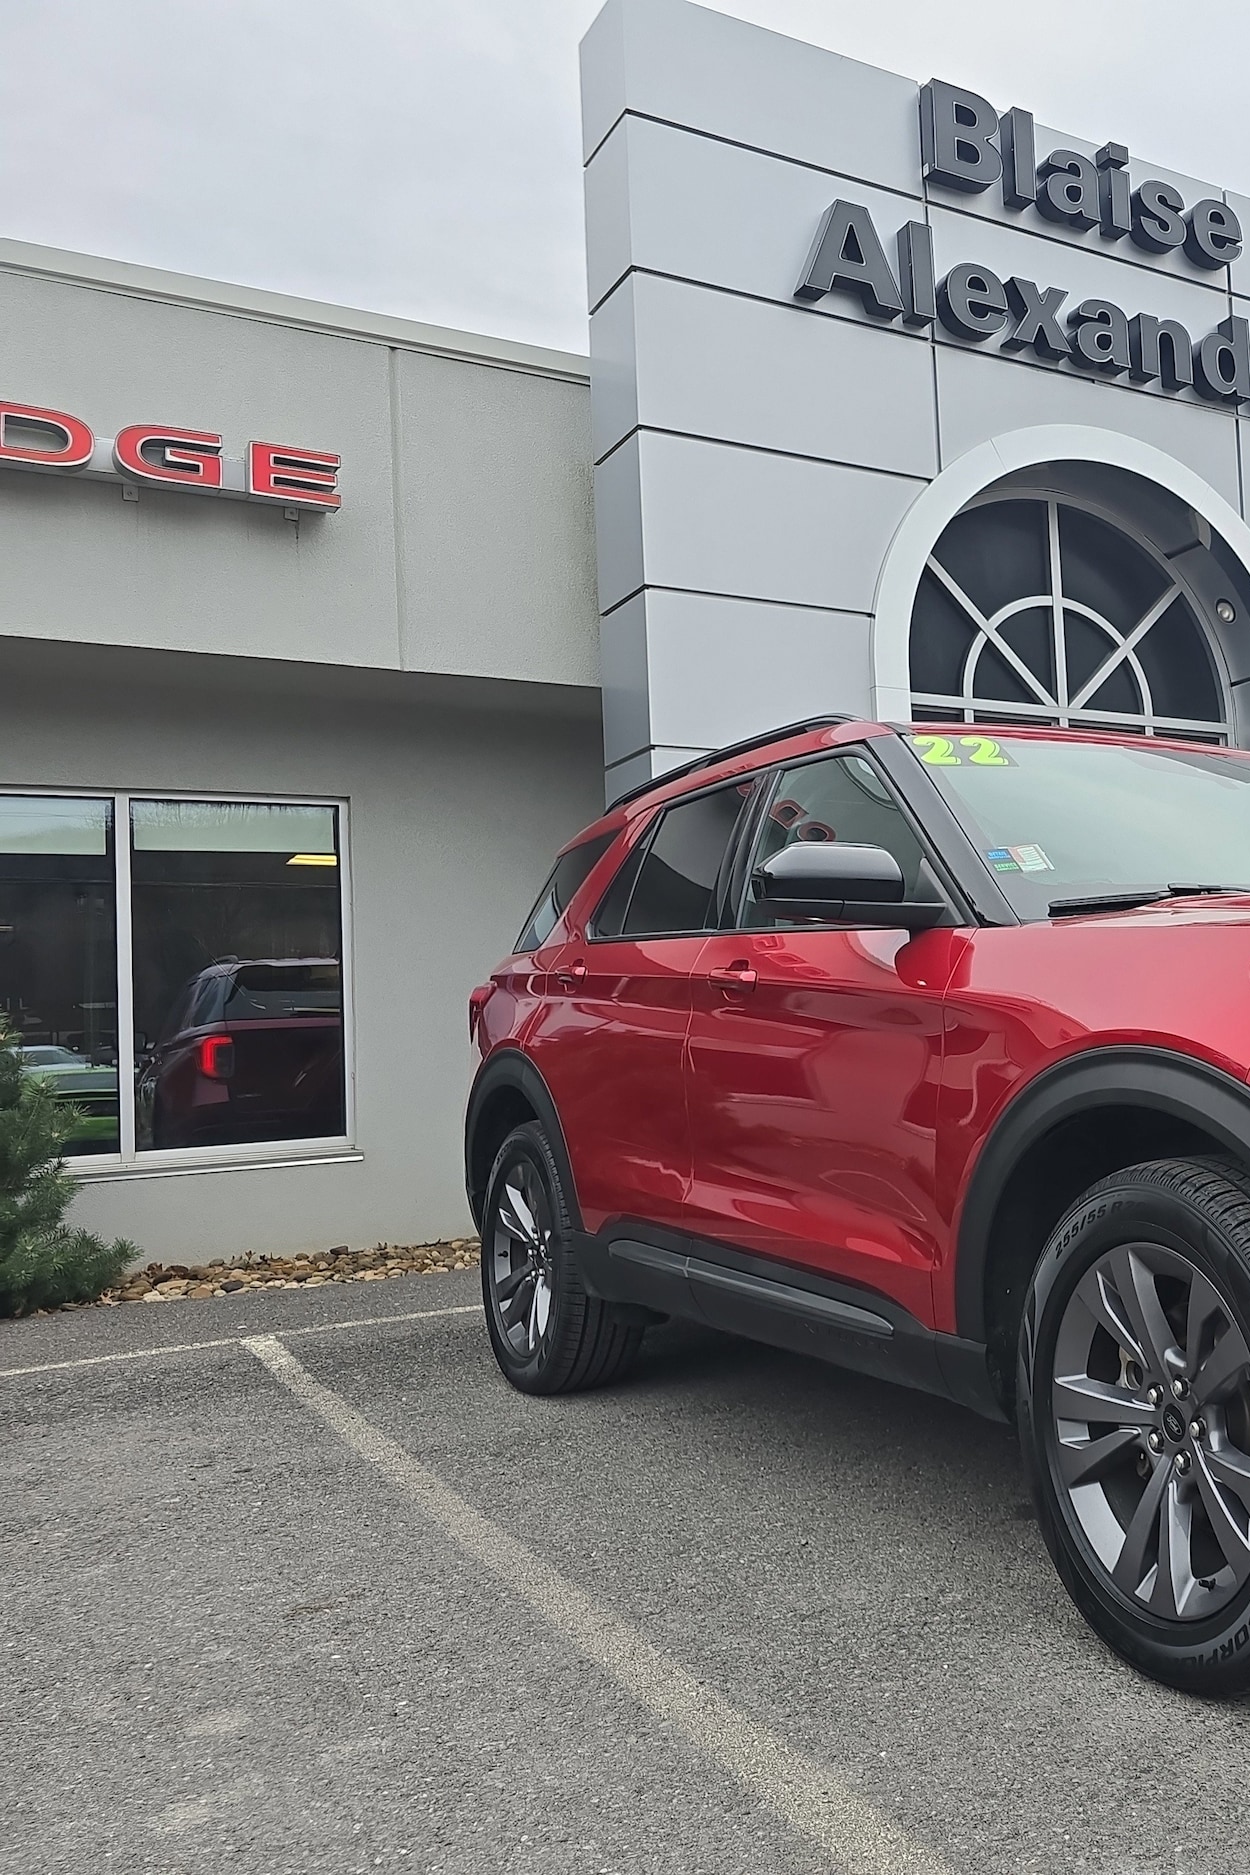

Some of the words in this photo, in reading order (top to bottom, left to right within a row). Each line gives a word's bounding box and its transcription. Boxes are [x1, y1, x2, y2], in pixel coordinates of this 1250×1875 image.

[919, 78, 1243, 270] Blaise
[912, 735, 1010, 766] 22
[1054, 1203, 1107, 1260] 255/55
